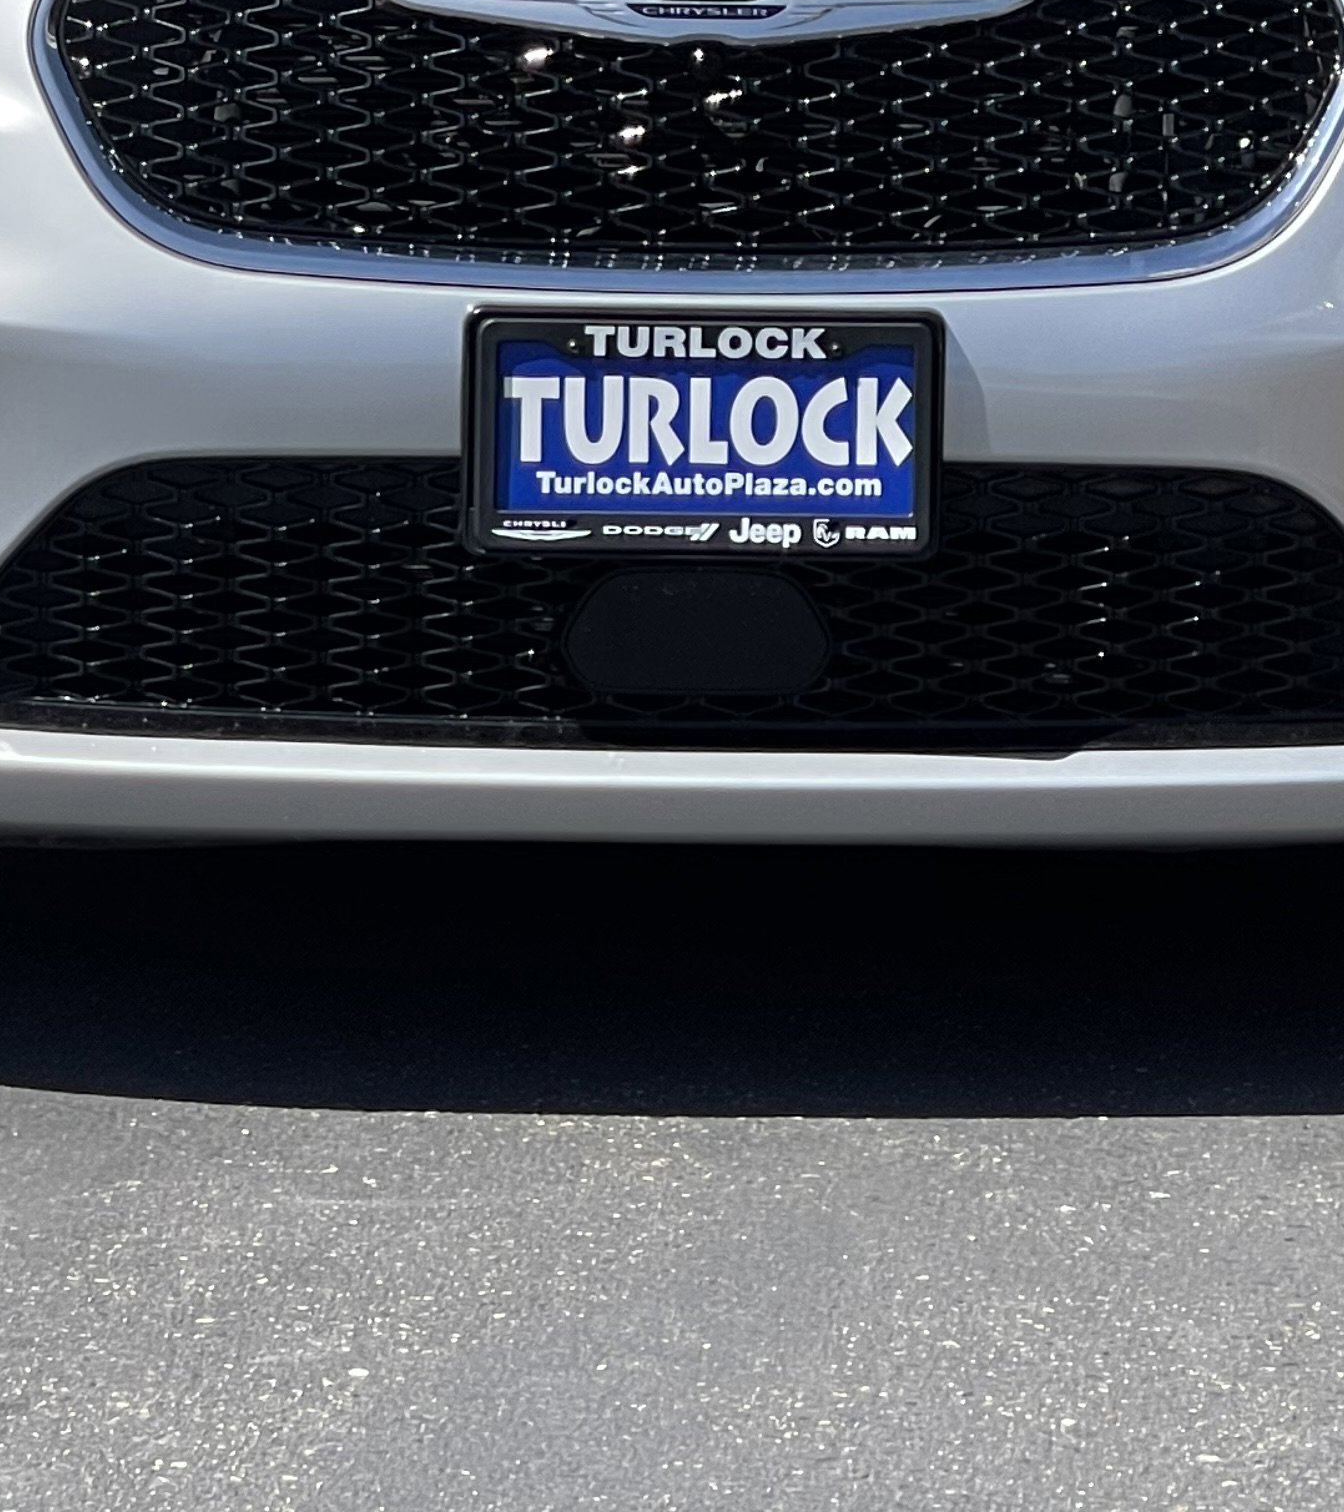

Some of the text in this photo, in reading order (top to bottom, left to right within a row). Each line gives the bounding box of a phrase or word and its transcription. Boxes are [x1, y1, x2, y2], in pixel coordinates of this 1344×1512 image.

[642, 6, 768, 17] CHRYSLER
[585, 326, 827, 359] TURLOCK
[504, 375, 914, 467] TURLOCK
[536, 471, 882, 497] TurlockAutoPlaza.com
[602, 525, 704, 536] DODGE
[728, 517, 802, 548] Jeep
[845, 526, 918, 541] RAM
